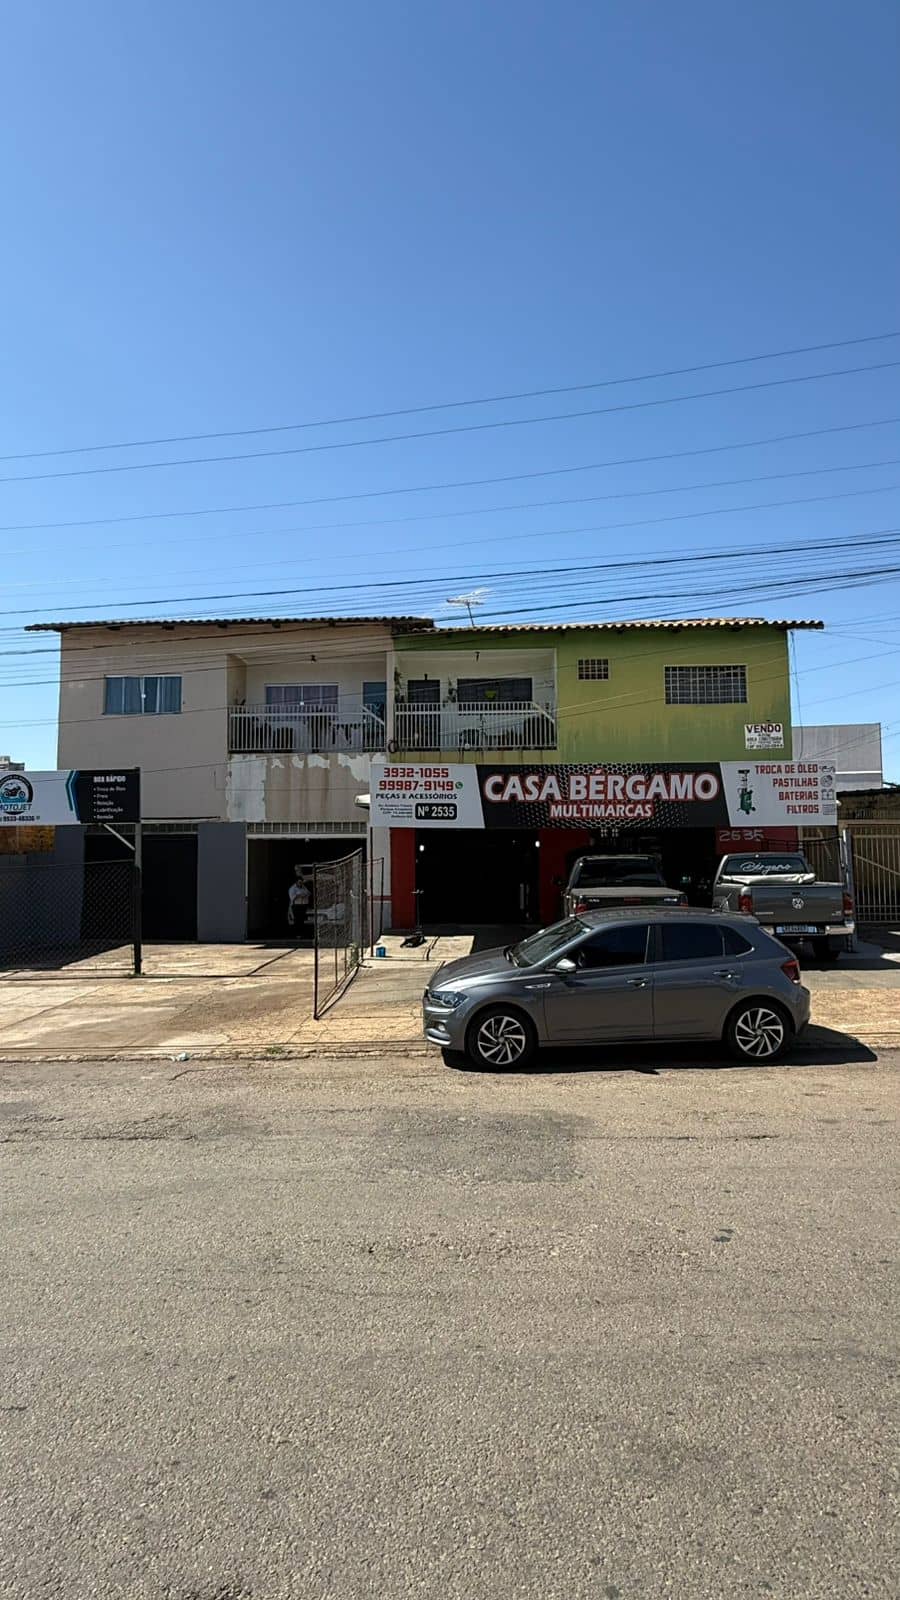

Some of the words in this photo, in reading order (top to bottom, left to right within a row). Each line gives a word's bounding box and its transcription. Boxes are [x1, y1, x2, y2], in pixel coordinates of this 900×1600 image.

[746, 724, 781, 733] VENDO
[383, 767, 449, 778] 3932-1055
[755, 764, 782, 774] TROCA
[785, 764, 795, 774] DE
[797, 761, 818, 774] ÓLEO
[378, 780, 454, 791] 99987-9149
[484, 774, 561, 801] CASA
[568, 768, 719, 801] BÉRGAMO
[772, 778, 818, 788] PASTILHAS
[375, 793, 400, 801] PEÇAS
[408, 792, 458, 800] ACESSÓRIOS
[778, 791, 819, 801] BATERIAS
[431, 806, 455, 817] 2535
[550, 803, 653, 818] MULTIMARCAS
[786, 804, 819, 815] FILTROS
